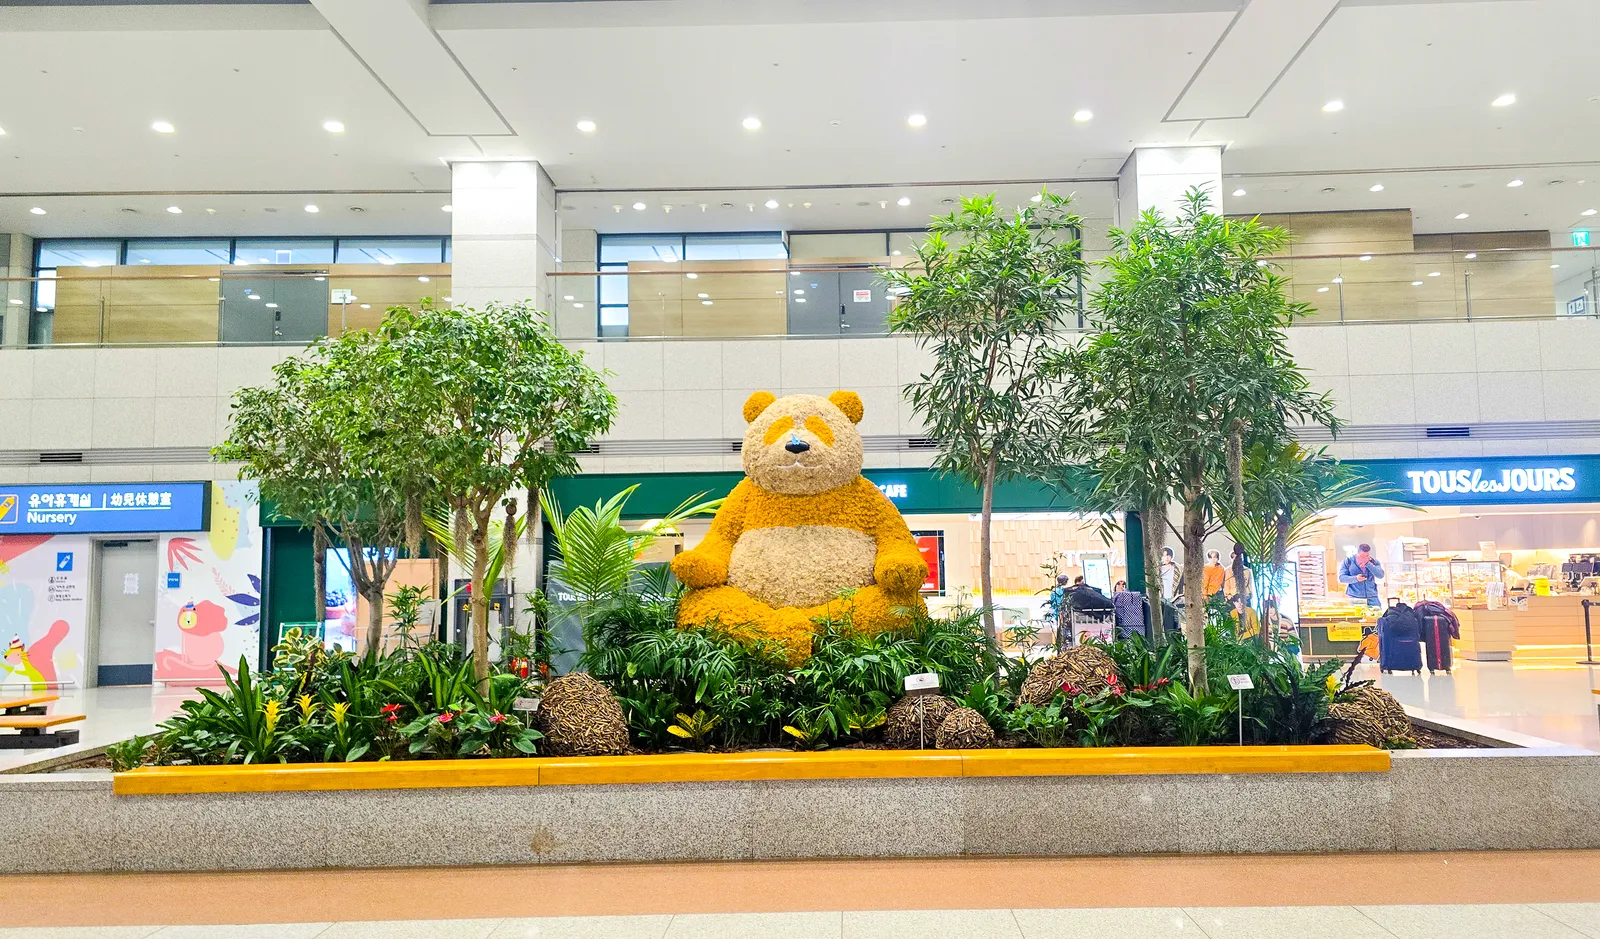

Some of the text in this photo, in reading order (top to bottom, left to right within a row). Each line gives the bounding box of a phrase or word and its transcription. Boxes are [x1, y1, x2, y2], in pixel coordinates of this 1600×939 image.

[1407, 467, 1576, 494] TOUS les JOURS
[28, 493, 92, 508] 유아휴게실
[27, 511, 77, 526] Nursery
